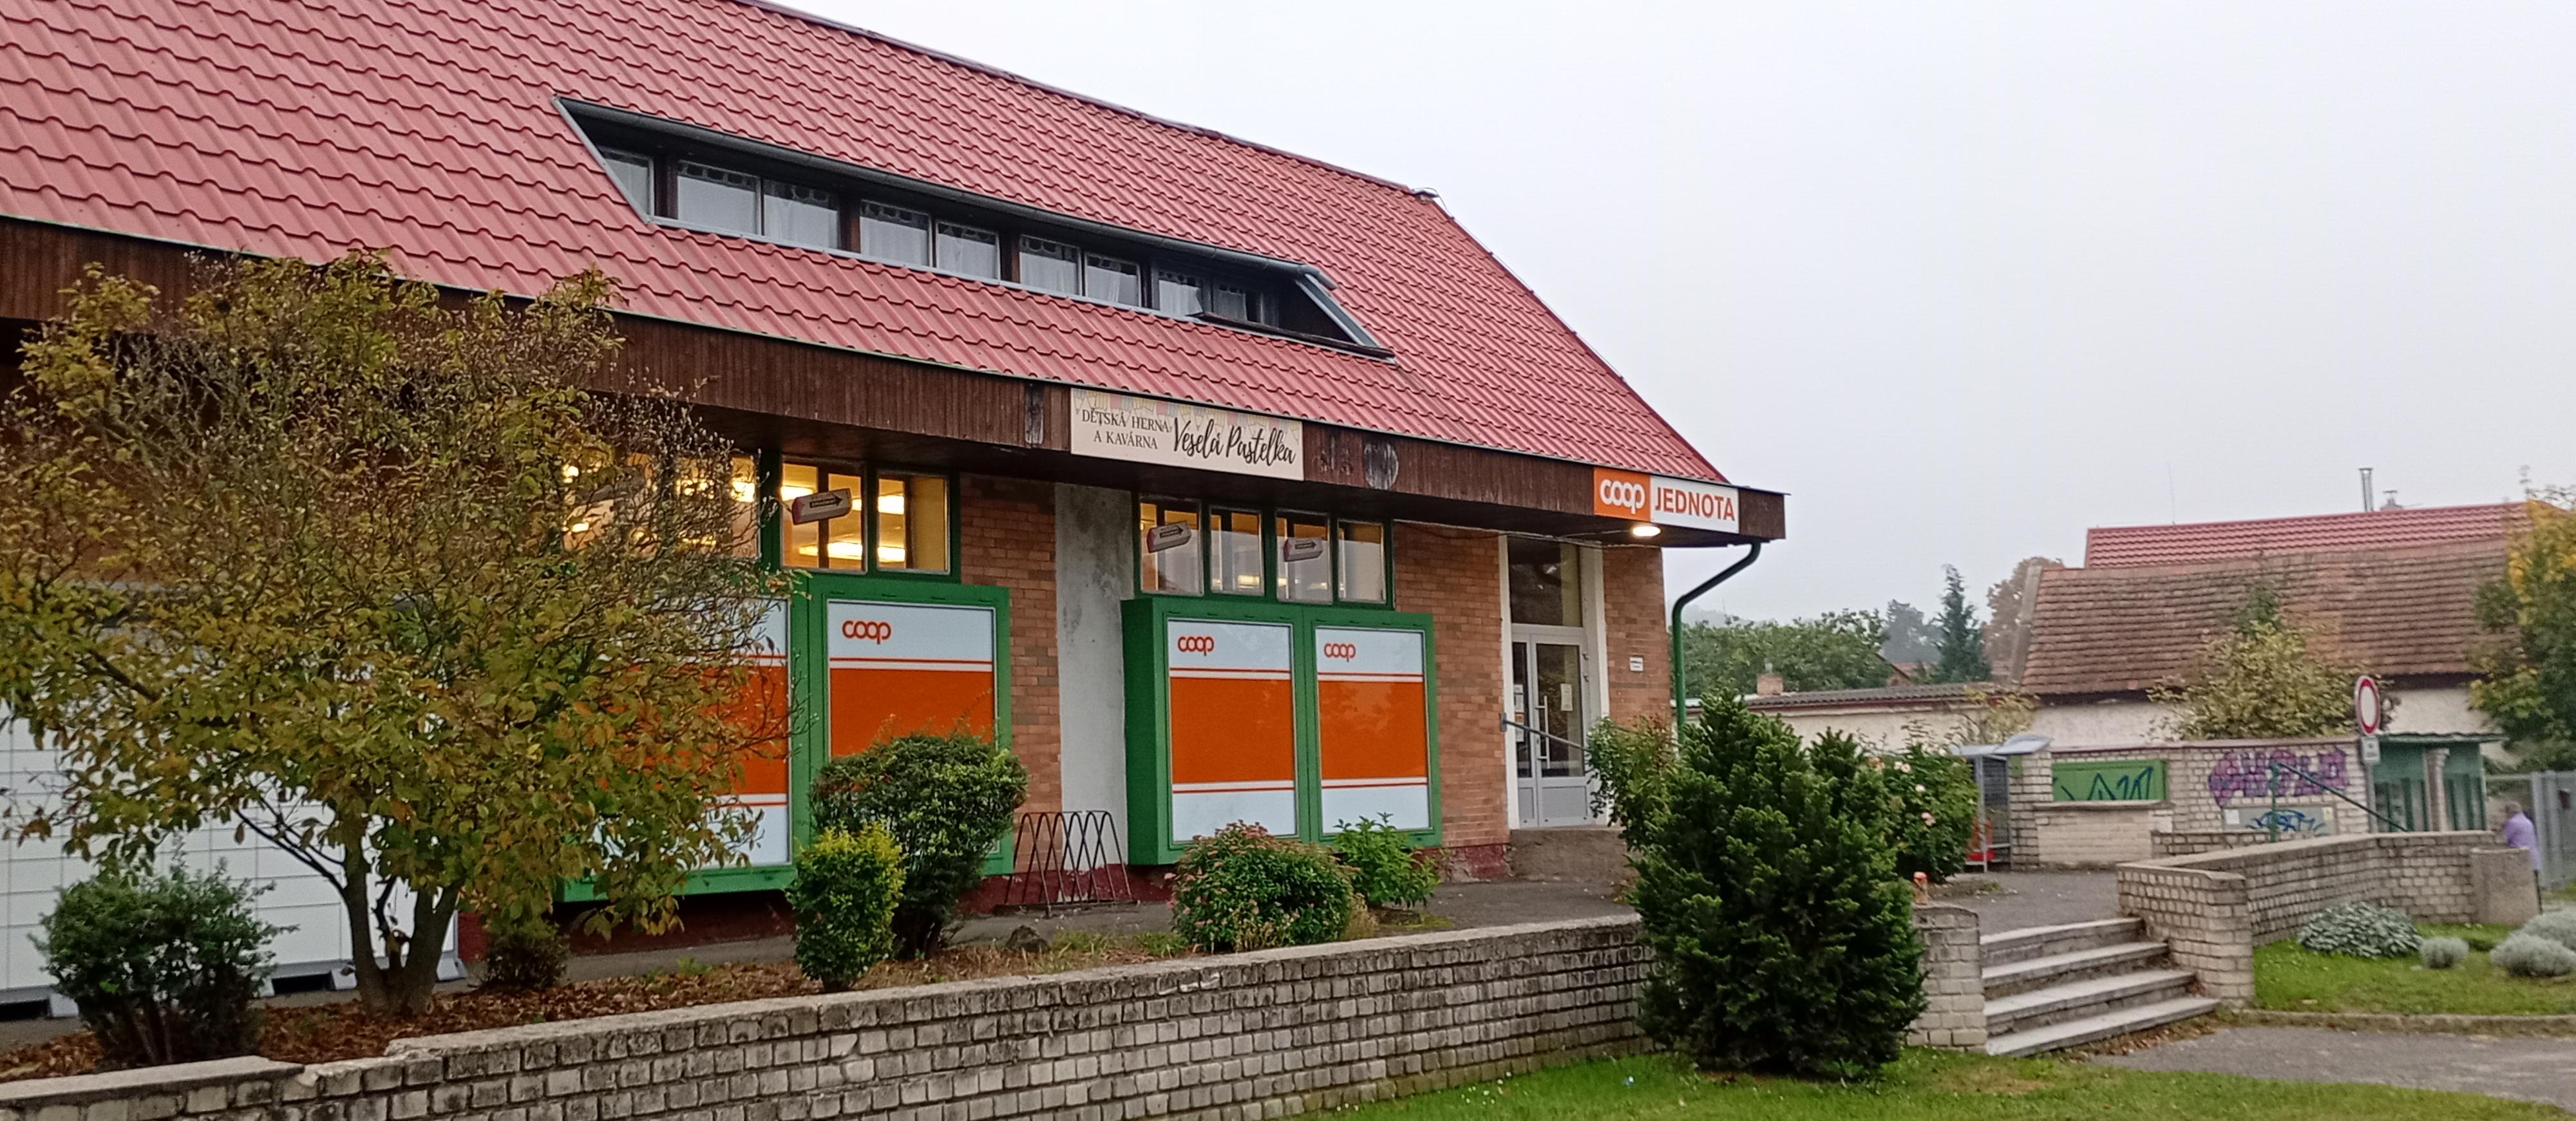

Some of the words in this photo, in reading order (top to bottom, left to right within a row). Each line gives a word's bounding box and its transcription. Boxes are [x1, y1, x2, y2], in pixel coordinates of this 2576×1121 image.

[1082, 408, 1126, 427] DĚTSKÁ
[1132, 416, 1170, 433] HERNA
[1094, 430, 1102, 442] A
[1106, 431, 1158, 449] KAVÁRNA
[1174, 417, 1224, 459] Veselá
[1226, 425, 1296, 466] Pastelka
[1600, 478, 1645, 514] coop
[1655, 487, 1736, 521] JEDNOTA
[842, 620, 891, 644] coop
[1178, 636, 1214, 655] coop
[1324, 643, 1356, 662] coop
